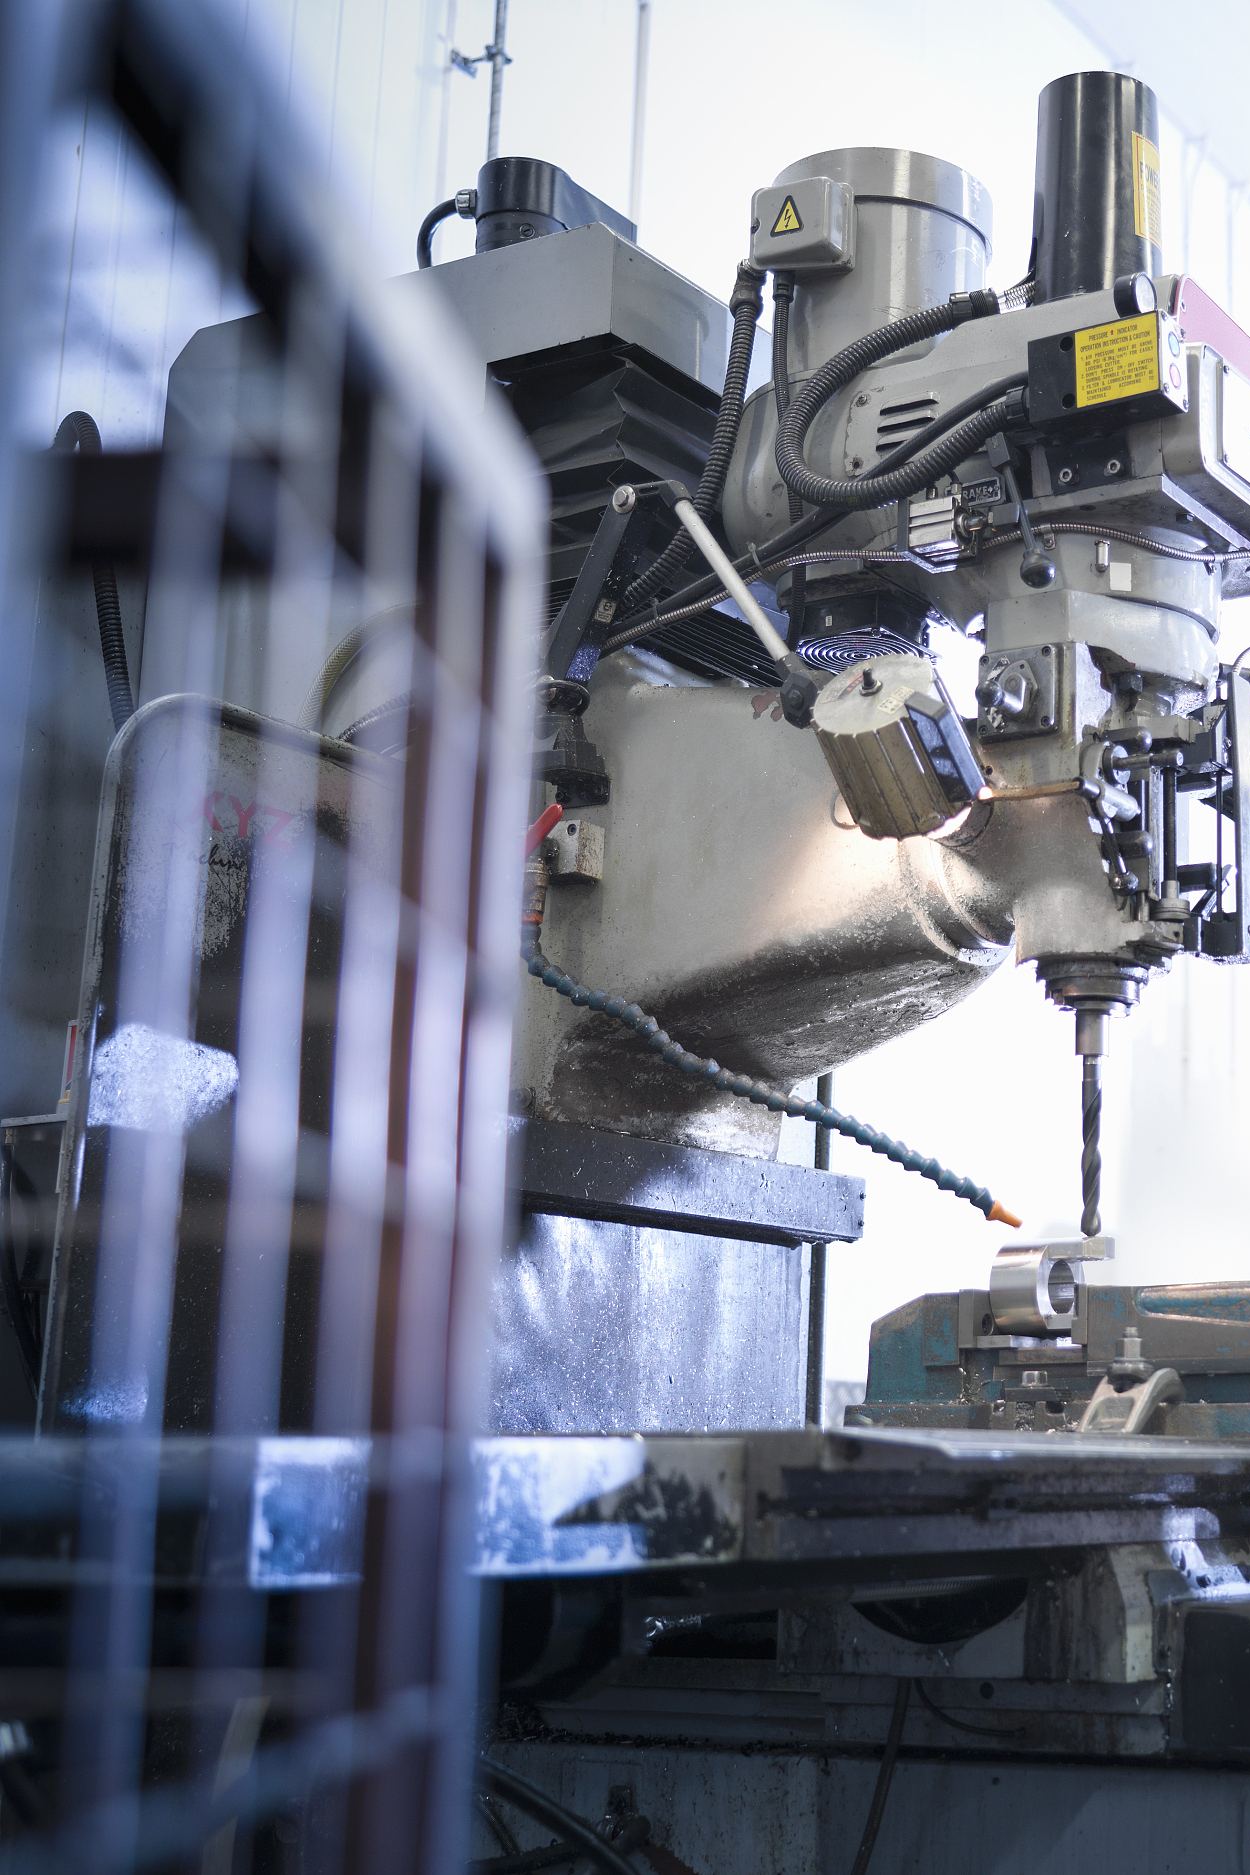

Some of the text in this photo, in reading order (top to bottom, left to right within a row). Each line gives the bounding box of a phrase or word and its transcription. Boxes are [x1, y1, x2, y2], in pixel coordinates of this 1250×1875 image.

[1089, 324, 1137, 342] PRESSURE INDICATOR
[1080, 342, 1101, 353] OPERATION
[1103, 336, 1128, 347] INSTRUCTION
[1133, 330, 1150, 340] CAUTION
[1095, 349, 1114, 358] PRESSURE
[962, 486, 988, 499] RAKE
